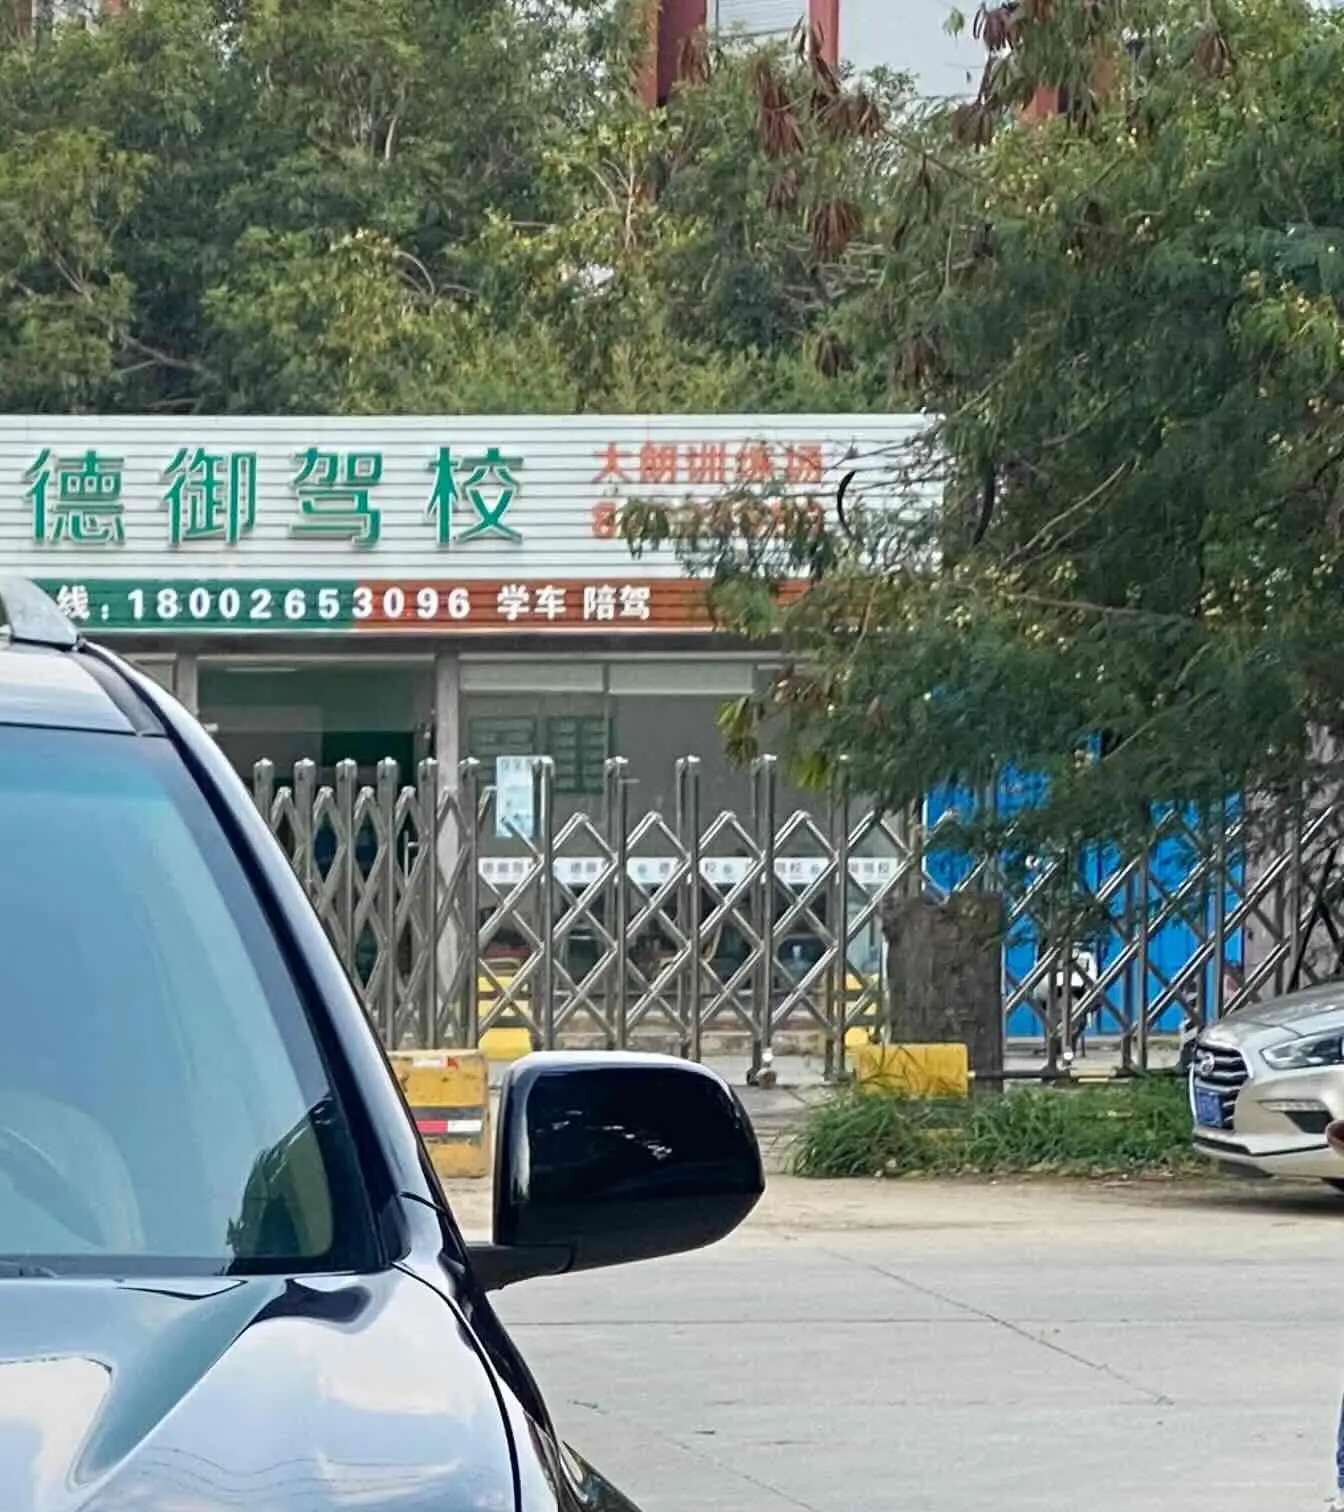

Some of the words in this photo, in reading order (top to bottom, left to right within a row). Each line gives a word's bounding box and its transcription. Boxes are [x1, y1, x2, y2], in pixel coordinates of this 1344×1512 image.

[25, 446, 524, 547] 德御驾校
[497, 584, 567, 620] 学车
[583, 585, 651, 620] 陪驾
